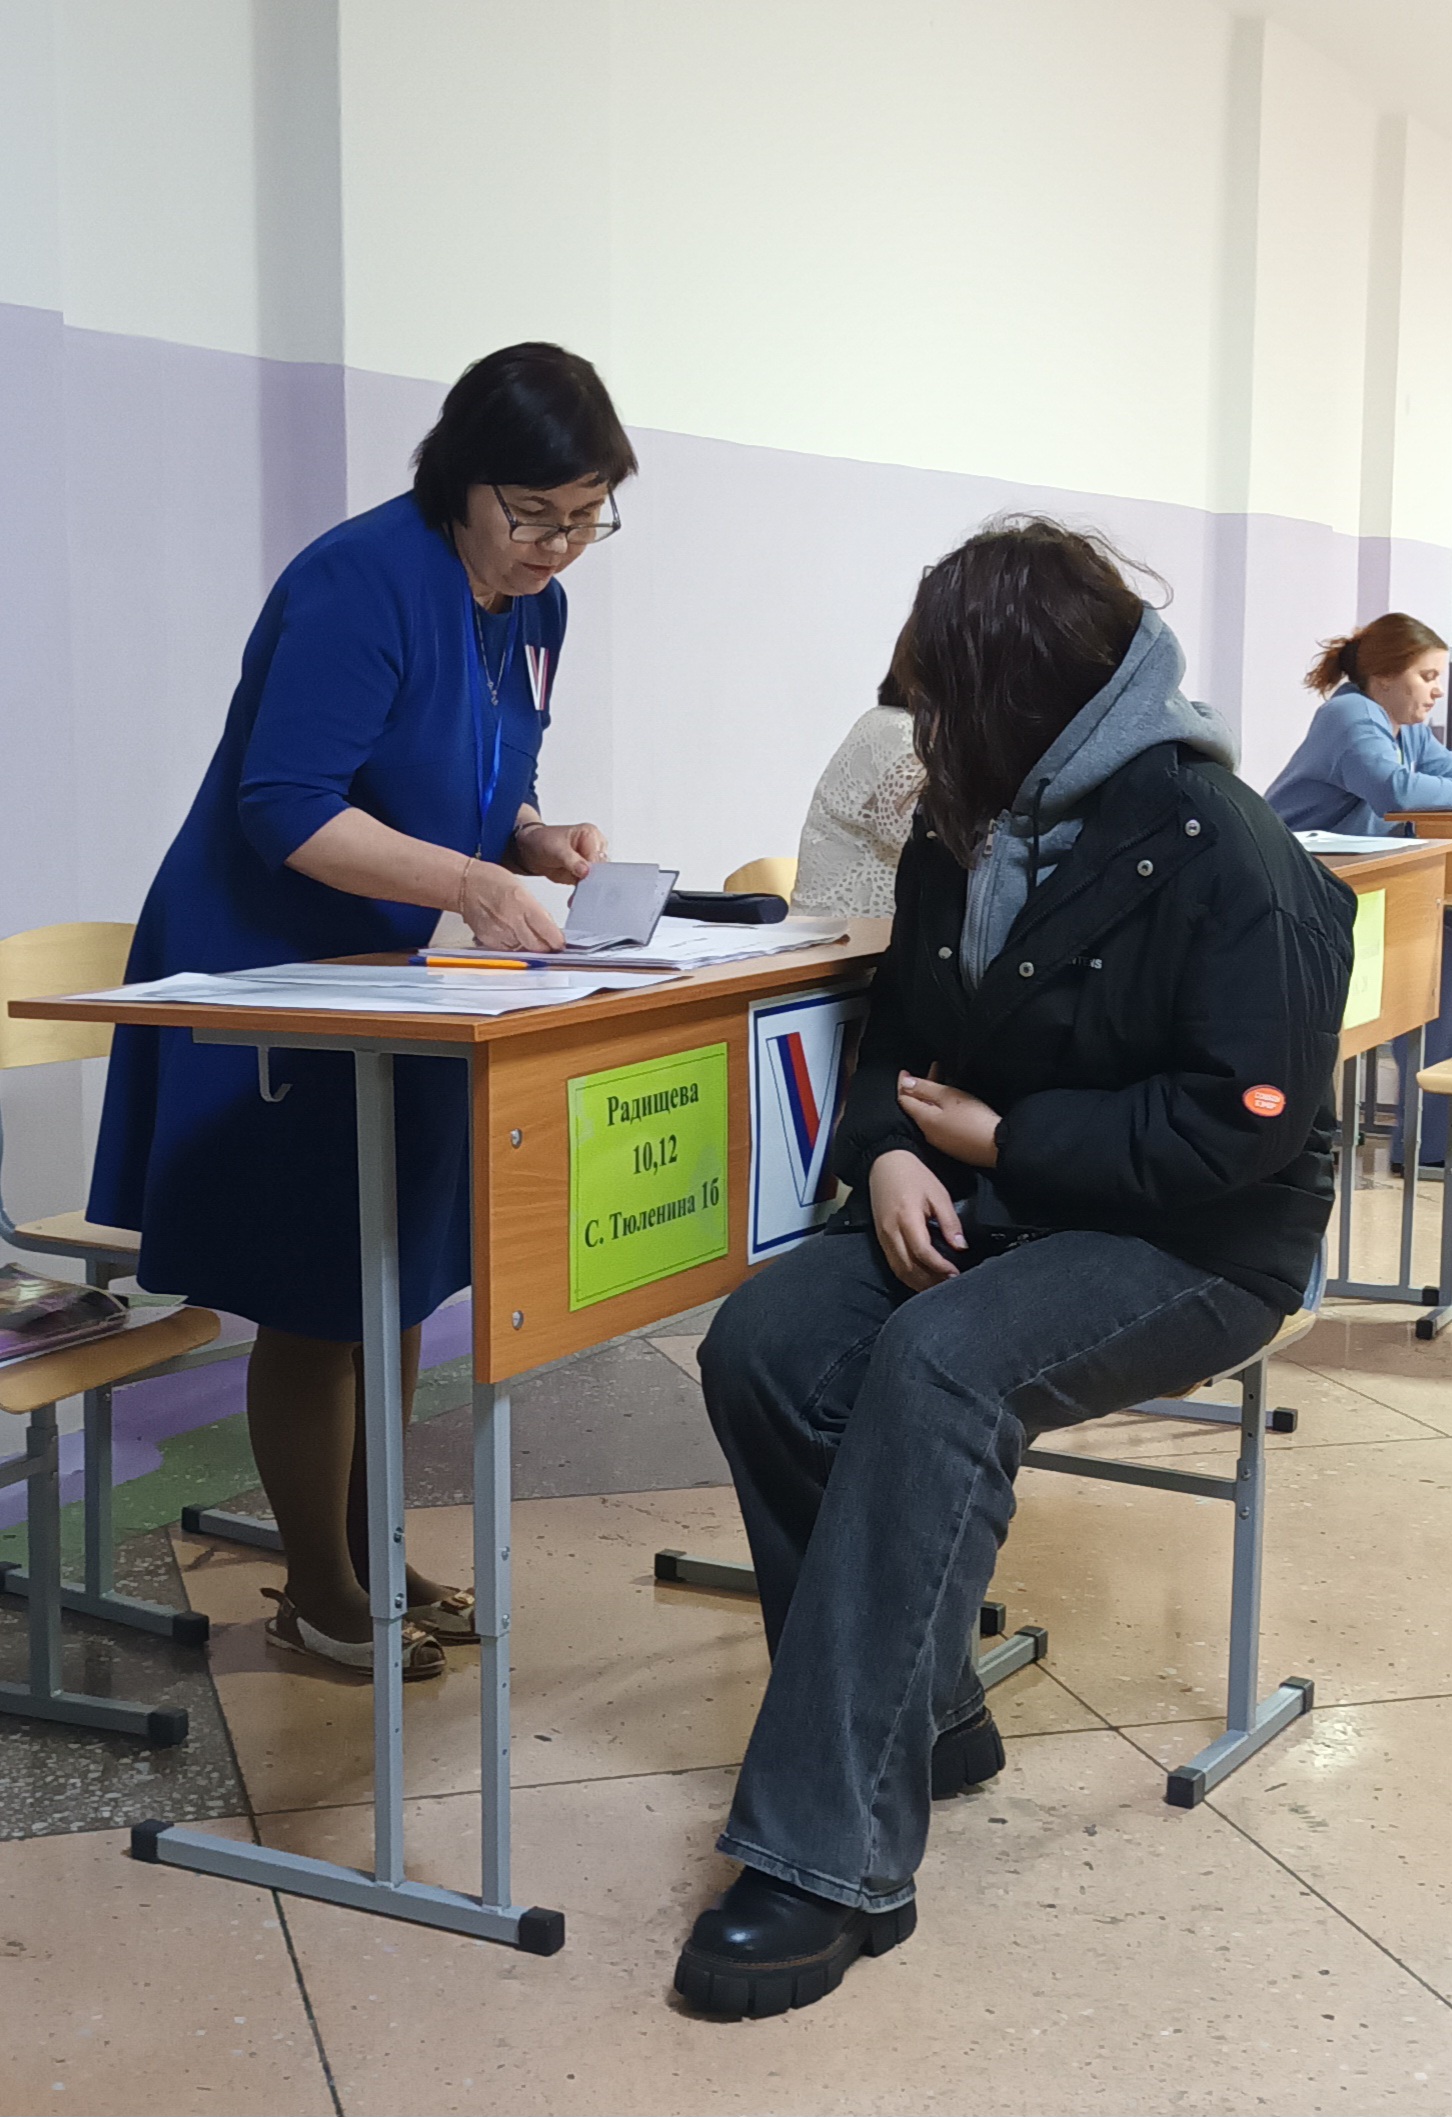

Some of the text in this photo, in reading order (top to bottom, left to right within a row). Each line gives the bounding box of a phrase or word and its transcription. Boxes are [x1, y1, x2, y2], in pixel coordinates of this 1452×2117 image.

[606, 1082, 699, 1127] Радищева
[633, 1134, 678, 1176] 10,12
[609, 1194, 696, 1241] Тюленина
